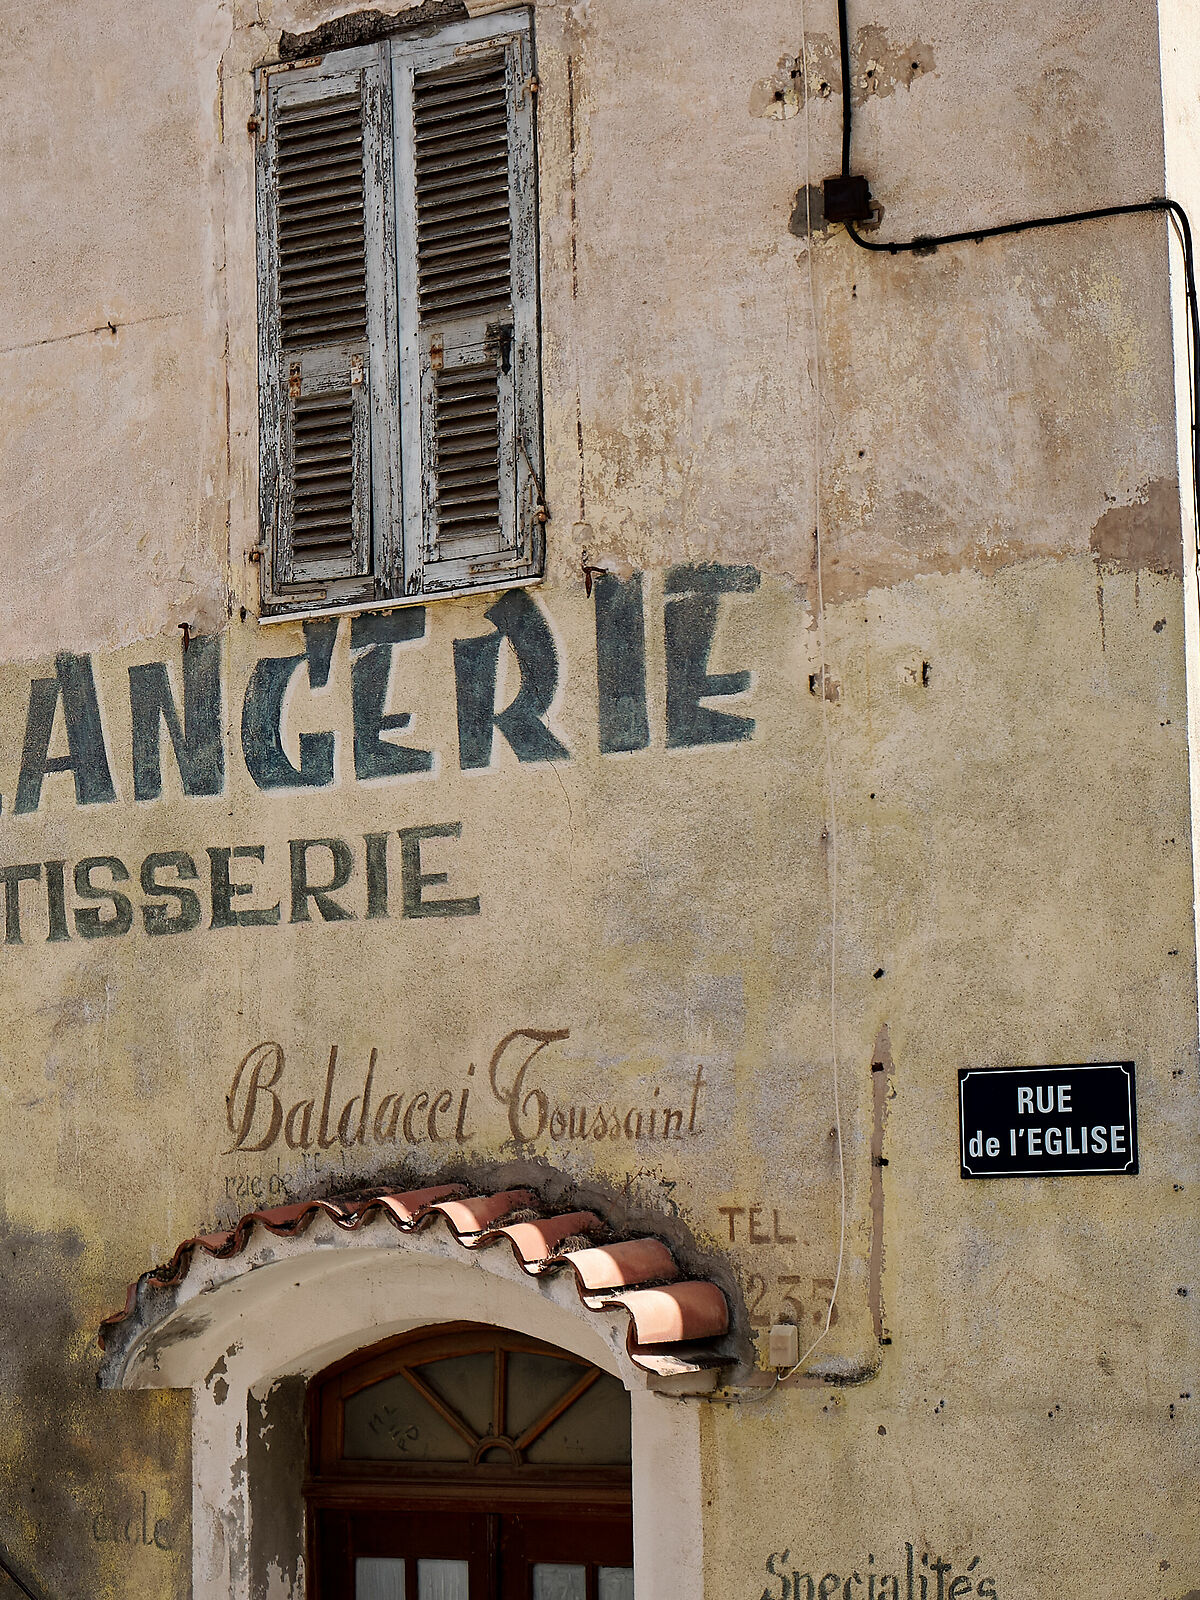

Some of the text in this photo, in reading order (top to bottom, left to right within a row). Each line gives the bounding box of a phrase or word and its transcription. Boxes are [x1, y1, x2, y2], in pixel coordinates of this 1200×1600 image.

[221, 1028, 705, 1155] Baldacci Toussaint
[1017, 1084, 1073, 1114] RUE
[968, 1125, 1127, 1158] de l'EGLISE
